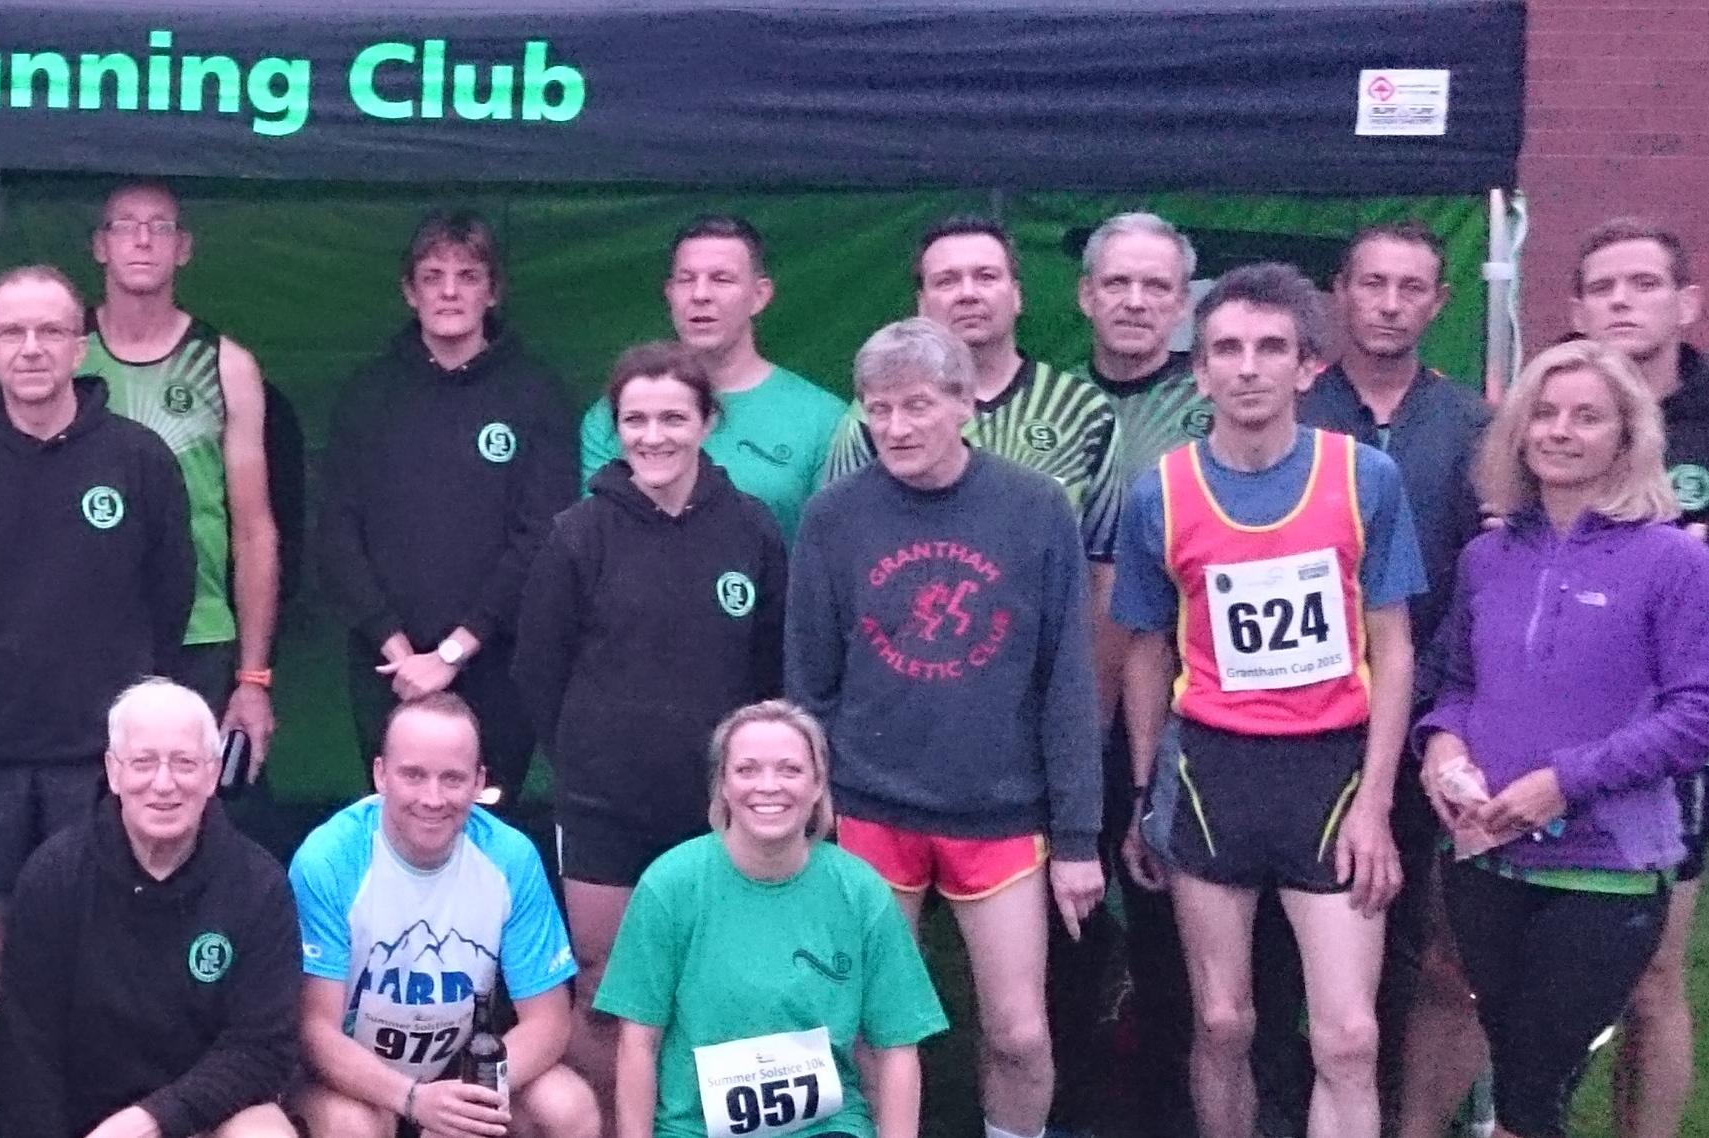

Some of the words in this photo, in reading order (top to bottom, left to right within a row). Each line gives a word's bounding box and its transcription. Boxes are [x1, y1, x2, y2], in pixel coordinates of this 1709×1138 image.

[348, 39, 586, 122] Club
[868, 542, 1002, 588] GRANTHAM
[861, 615, 964, 680] ATHLETIC
[968, 611, 1012, 667] CLUB
[1227, 591, 1329, 654] 624
[1226, 665, 1288, 678] Grantham
[1292, 660, 1315, 674] Cup
[1317, 653, 1342, 669] 2015
[365, 1013, 411, 1029] Summer
[414, 1020, 455, 1031] Solstice
[374, 1027, 460, 1064] 972
[708, 1071, 756, 1088] Summer
[759, 1062, 802, 1080] Solstice
[805, 1057, 826, 1071] 10k
[726, 1073, 820, 1135] 957
